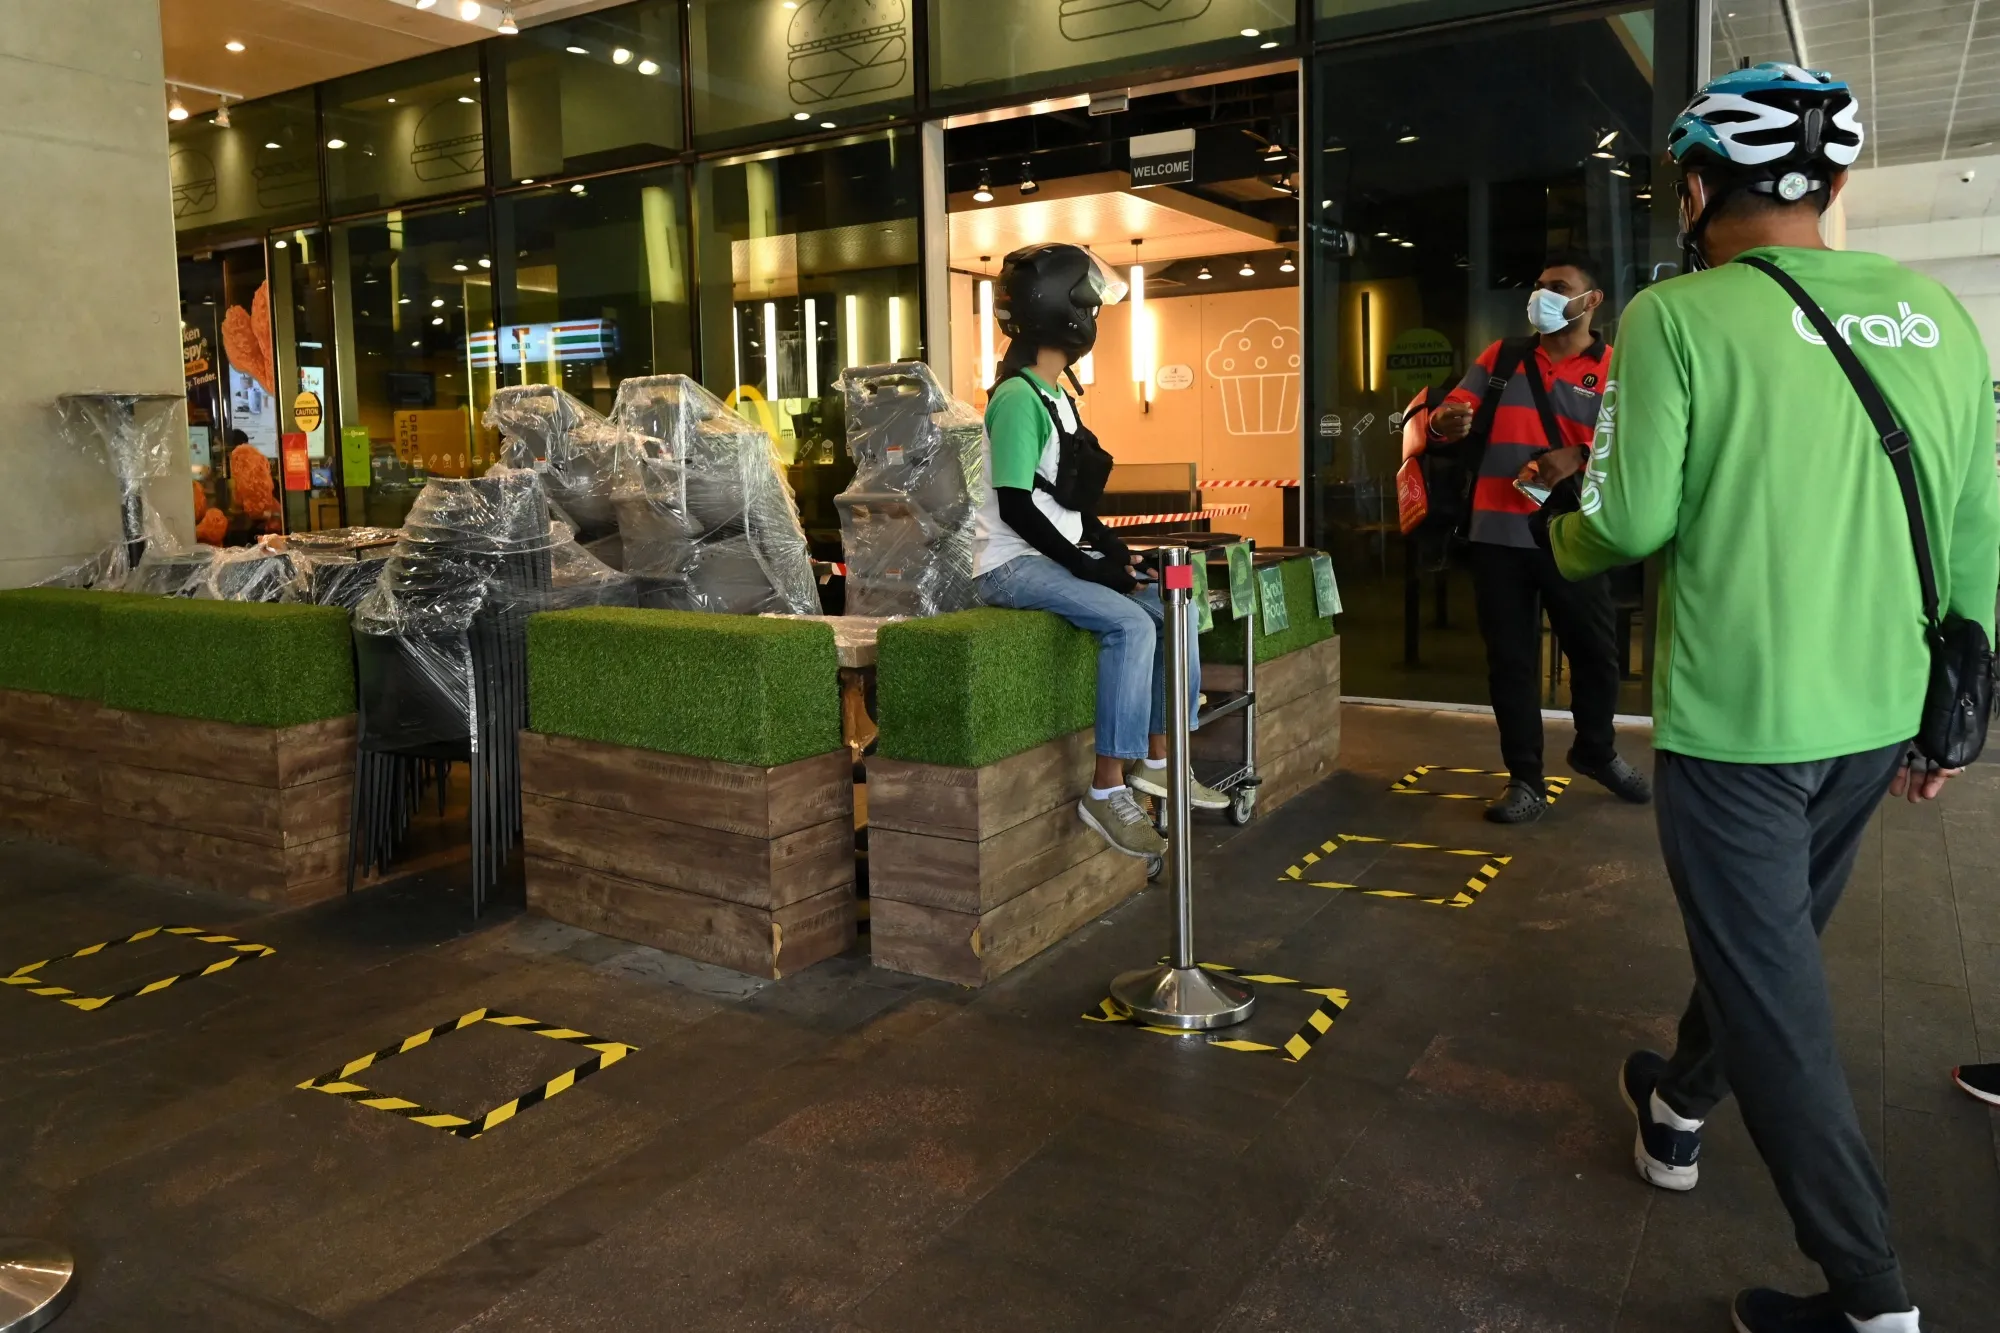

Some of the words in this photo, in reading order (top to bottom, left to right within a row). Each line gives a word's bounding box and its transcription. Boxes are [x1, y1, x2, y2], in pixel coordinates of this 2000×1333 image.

[1133, 161, 1190, 178] WELCOME
[1390, 354, 1451, 368] CAUTION
[193, 373, 217, 386] Tender.
[295, 408, 319, 416] CAUTION
[400, 420, 409, 455] HERE
